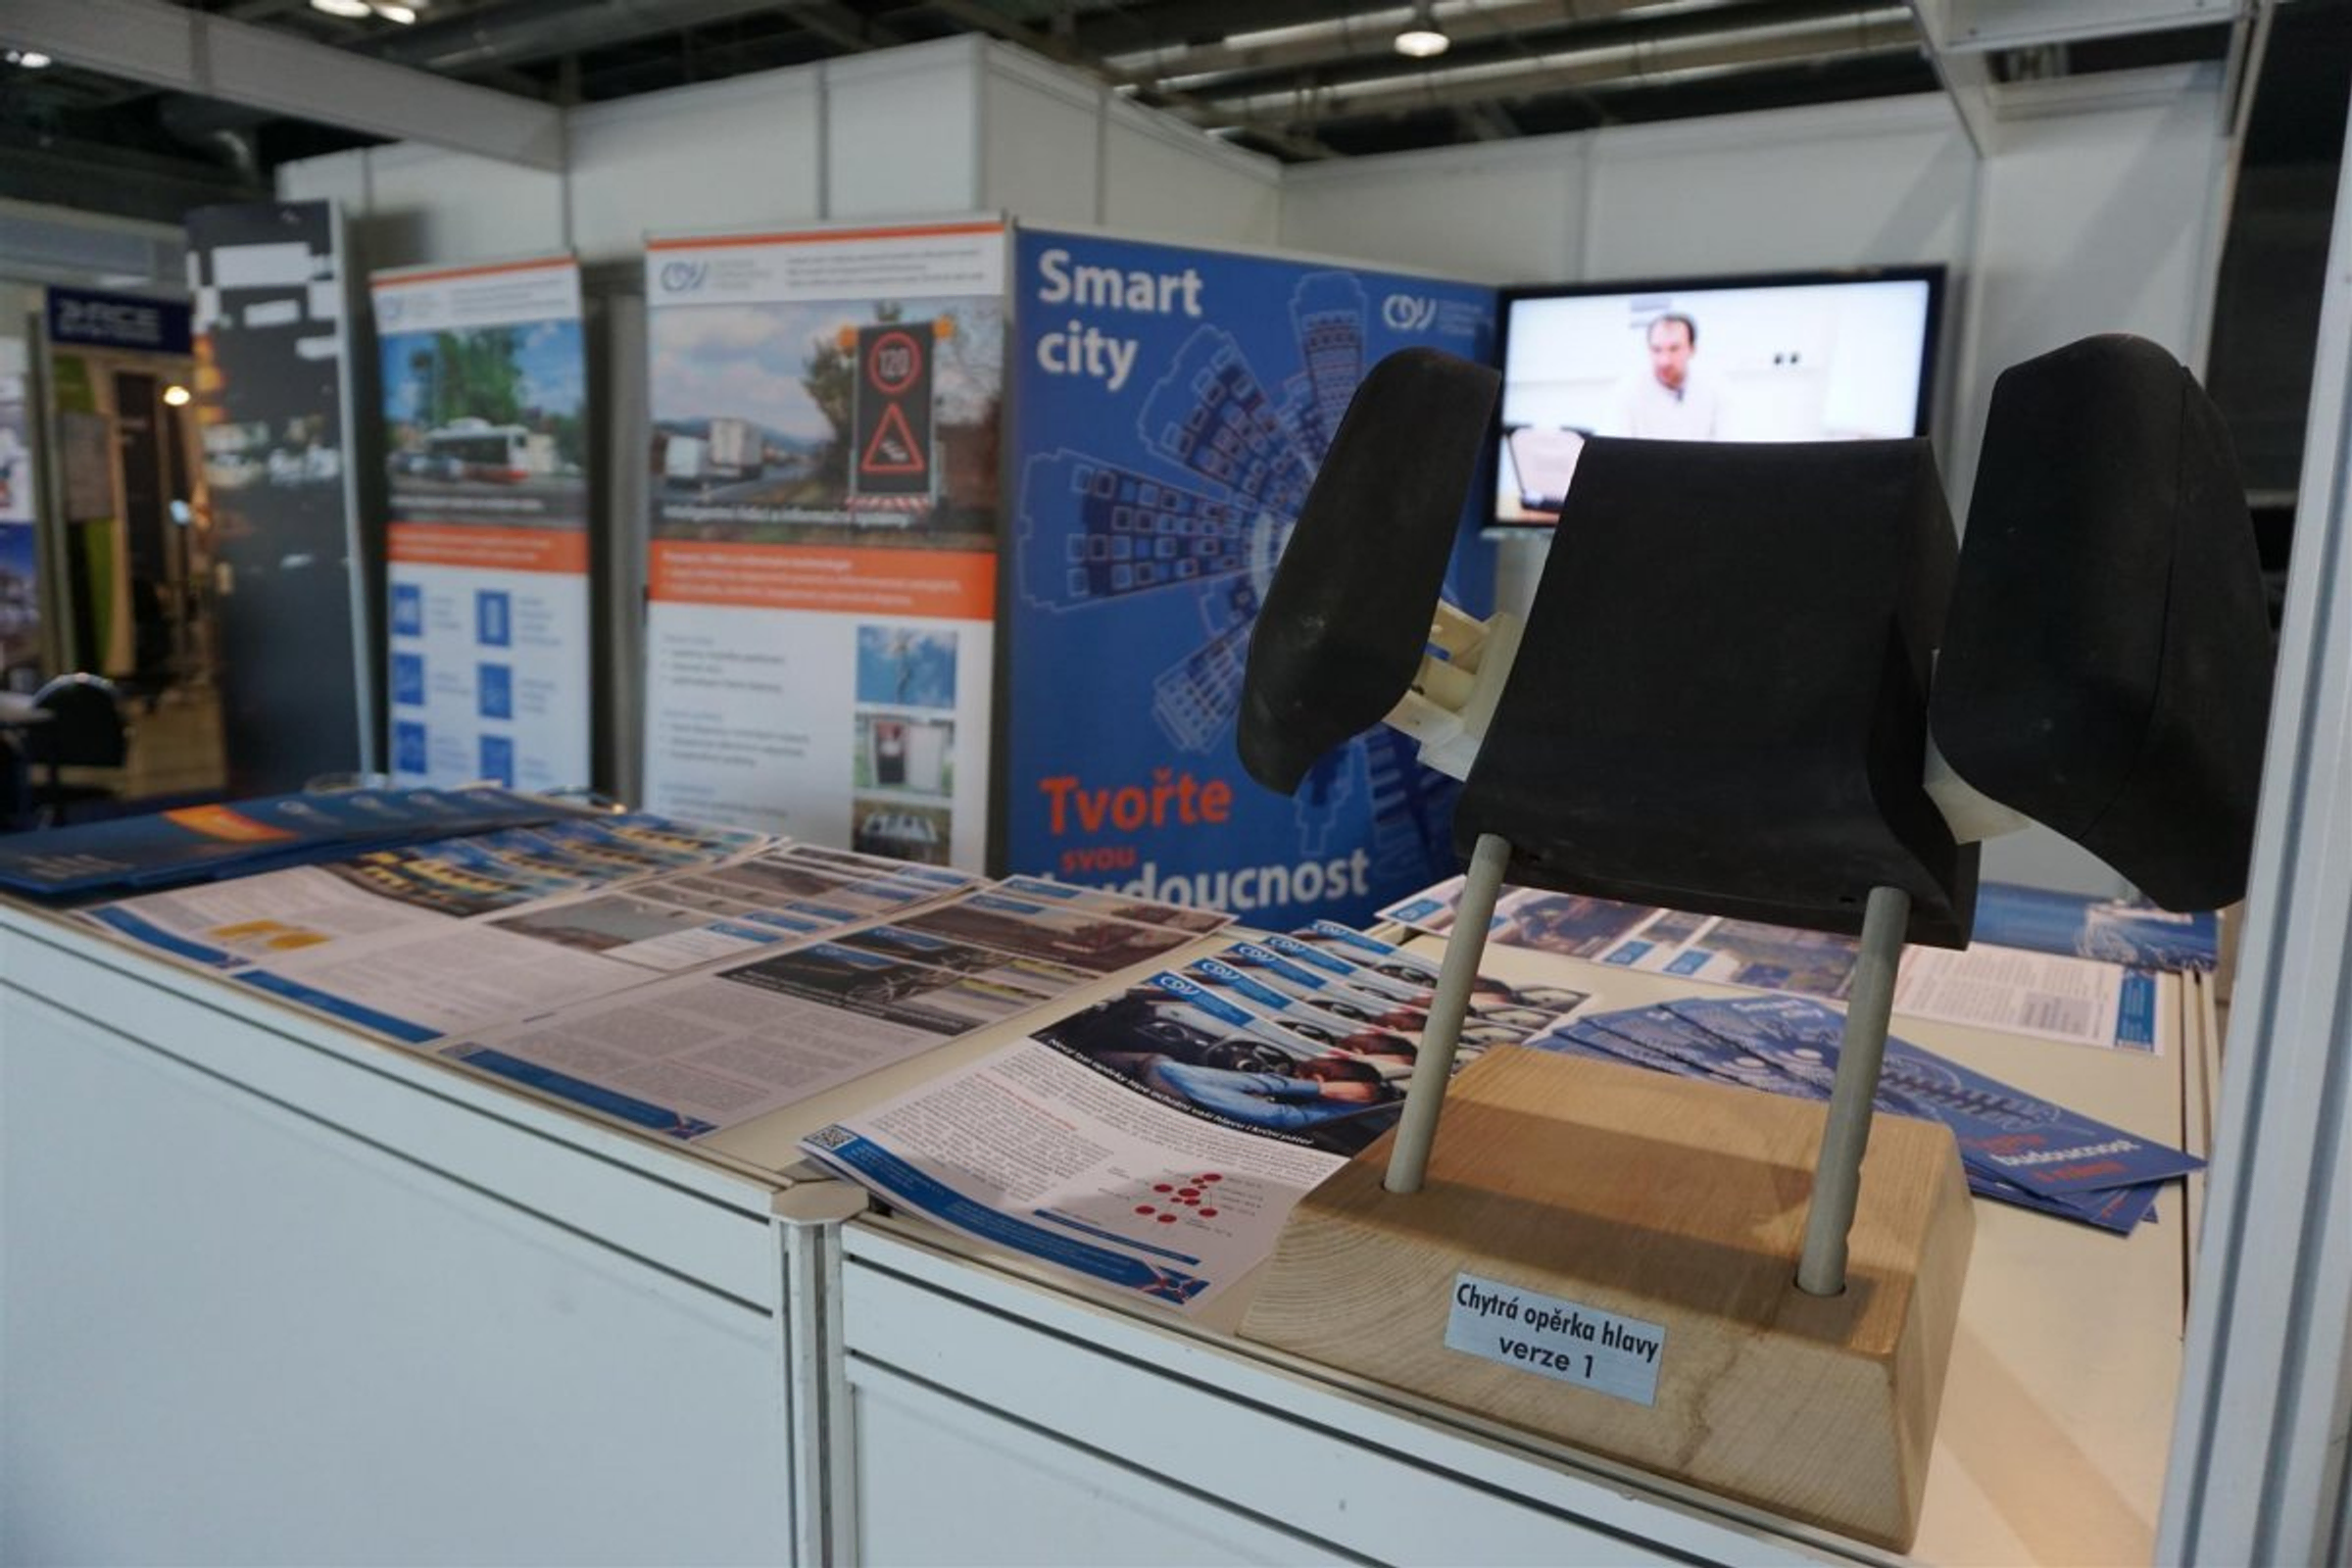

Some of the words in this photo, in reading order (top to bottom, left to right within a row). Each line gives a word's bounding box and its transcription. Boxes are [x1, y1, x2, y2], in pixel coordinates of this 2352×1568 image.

[1038, 249, 1203, 318] Smart
[1036, 321, 1139, 391] city
[1040, 769, 1233, 835] Tvořte
[1042, 847, 1369, 911] doucnost
[1060, 846, 1137, 873] svou
[1456, 1283, 1519, 1321] Chytrá
[1524, 1307, 1595, 1342] opěrka
[1600, 1321, 1660, 1364] hlavy
[1499, 1336, 1571, 1372] verze
[1584, 1354, 1594, 1378] 1
